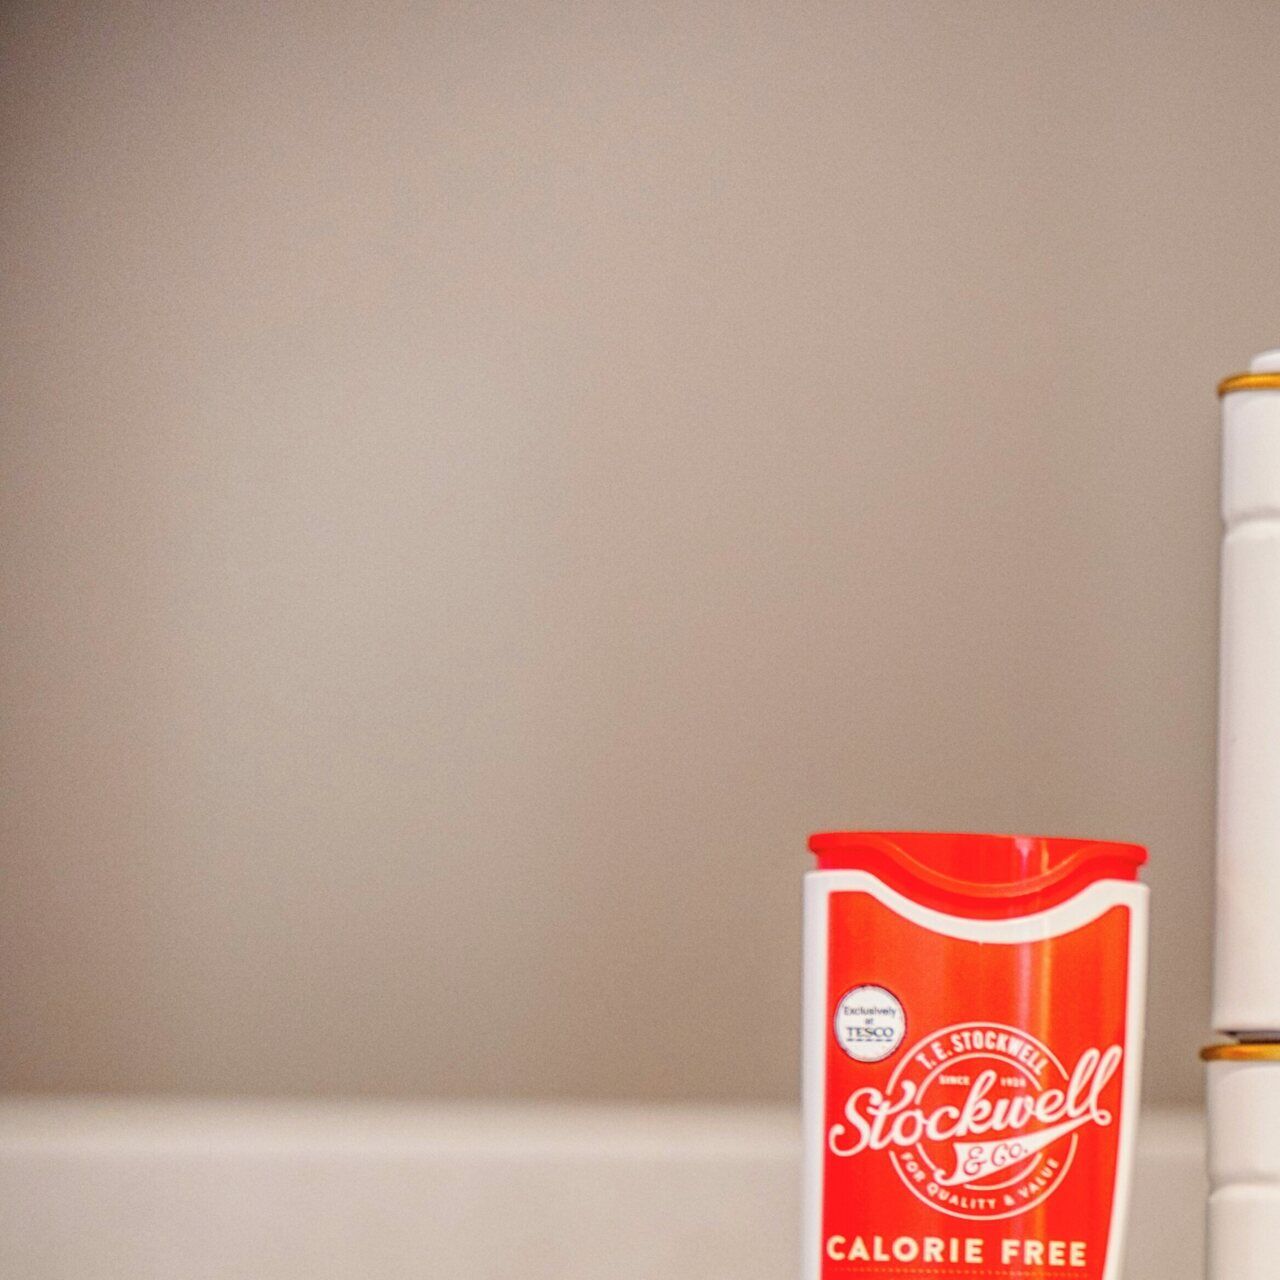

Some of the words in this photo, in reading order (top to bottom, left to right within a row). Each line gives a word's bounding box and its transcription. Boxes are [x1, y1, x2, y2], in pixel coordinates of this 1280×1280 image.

[843, 1005, 896, 1019] Exclusively
[846, 1026, 894, 1038] TESCO
[950, 1030, 1049, 1076] STOCKWELL
[939, 1074, 970, 1086] SINCE
[828, 1044, 1124, 1158] Stockwell
[963, 1146, 987, 1176] &
[902, 1152, 926, 1183] FOR
[927, 1182, 997, 1210] QUALITY
[1003, 1194, 1016, 1206] &
[1017, 1158, 1059, 1198] VALUE
[825, 1234, 985, 1264] CALORIE
[1001, 1239, 1087, 1267] FREE
